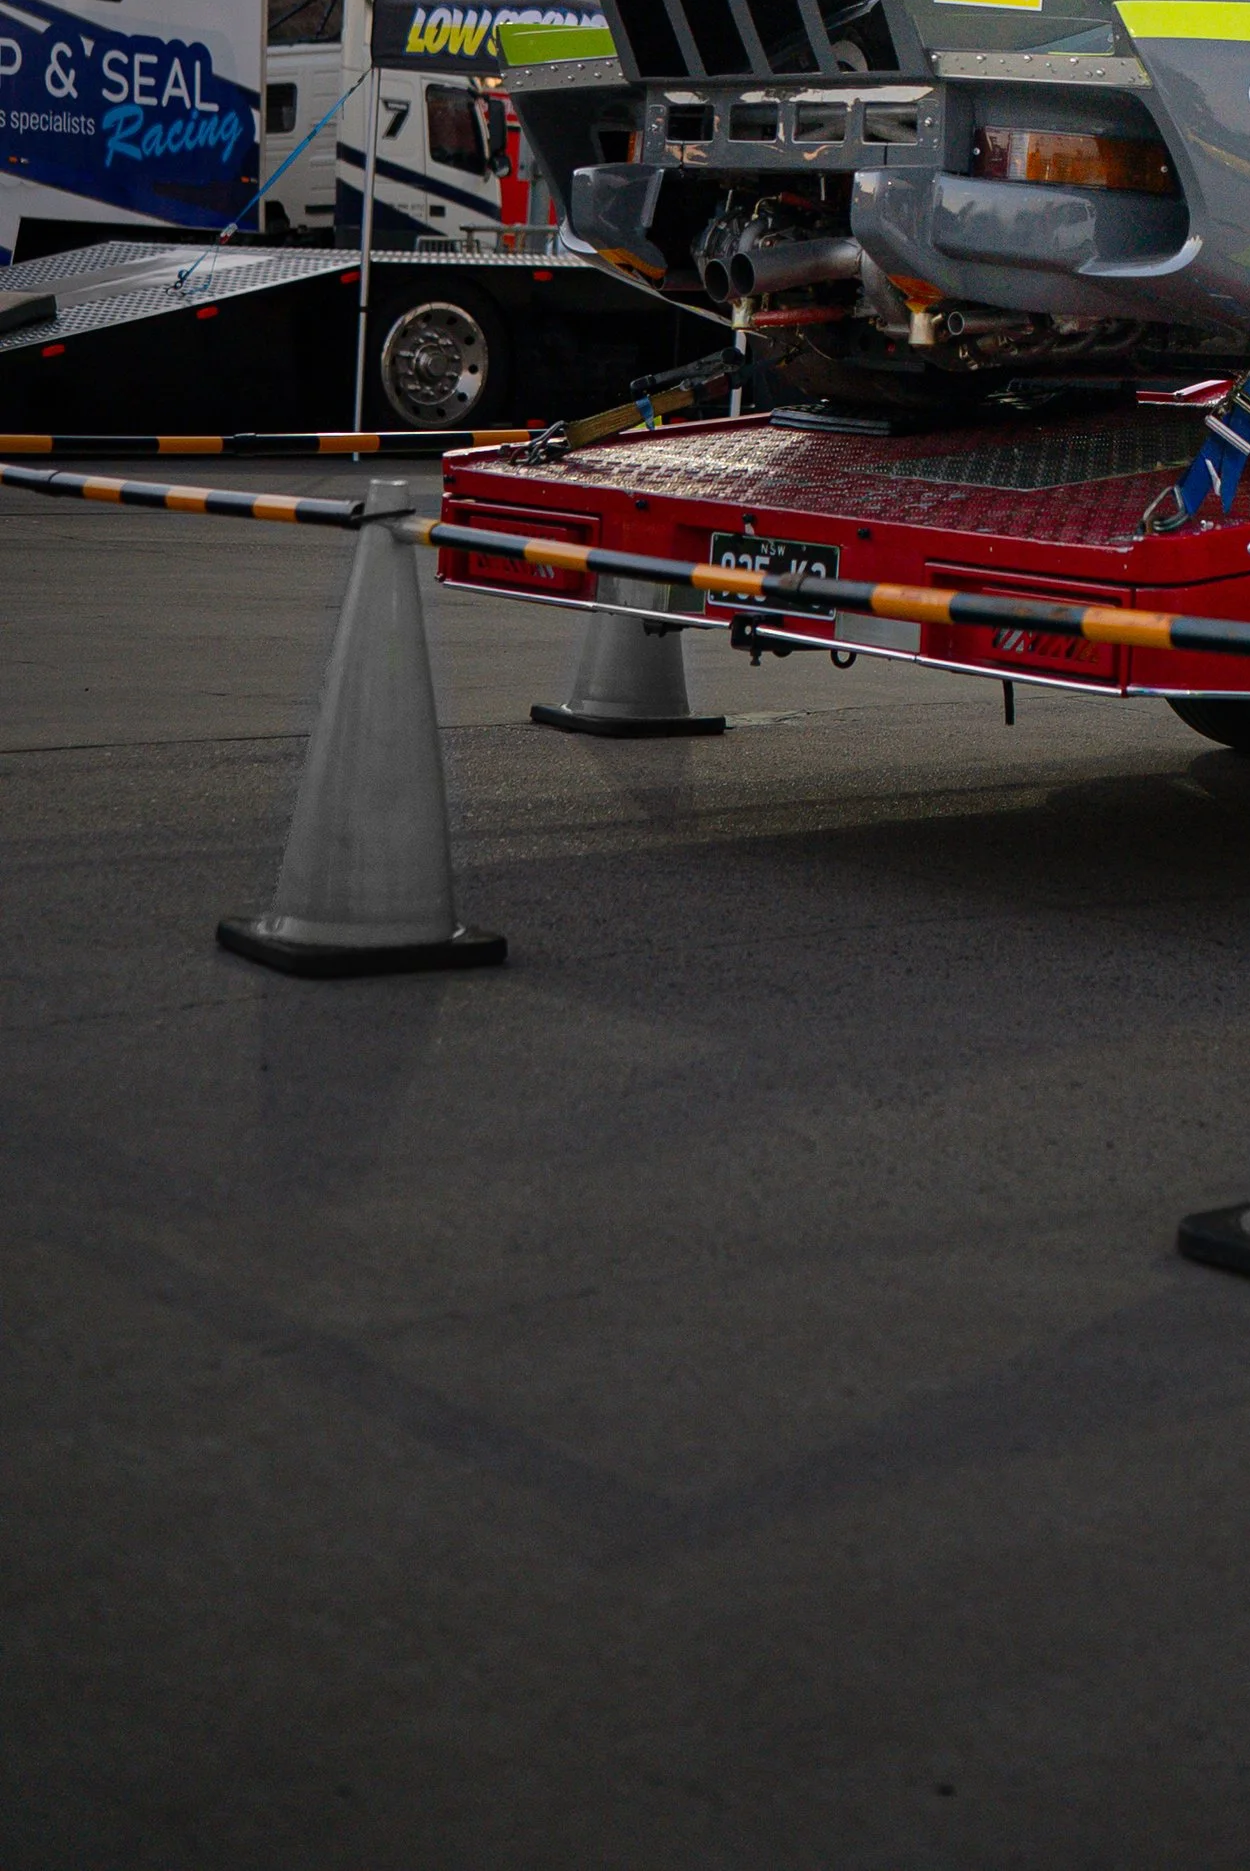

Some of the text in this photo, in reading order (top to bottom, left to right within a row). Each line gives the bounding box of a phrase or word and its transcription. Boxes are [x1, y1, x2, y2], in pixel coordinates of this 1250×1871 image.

[406, 6, 494, 57] LOW
[45, 41, 78, 99] &
[102, 50, 219, 112] SEAL
[10, 109, 96, 136] specialists
[102, 103, 243, 168] Racing
[381, 98, 411, 140] 7
[761, 543, 786, 556] NSW
